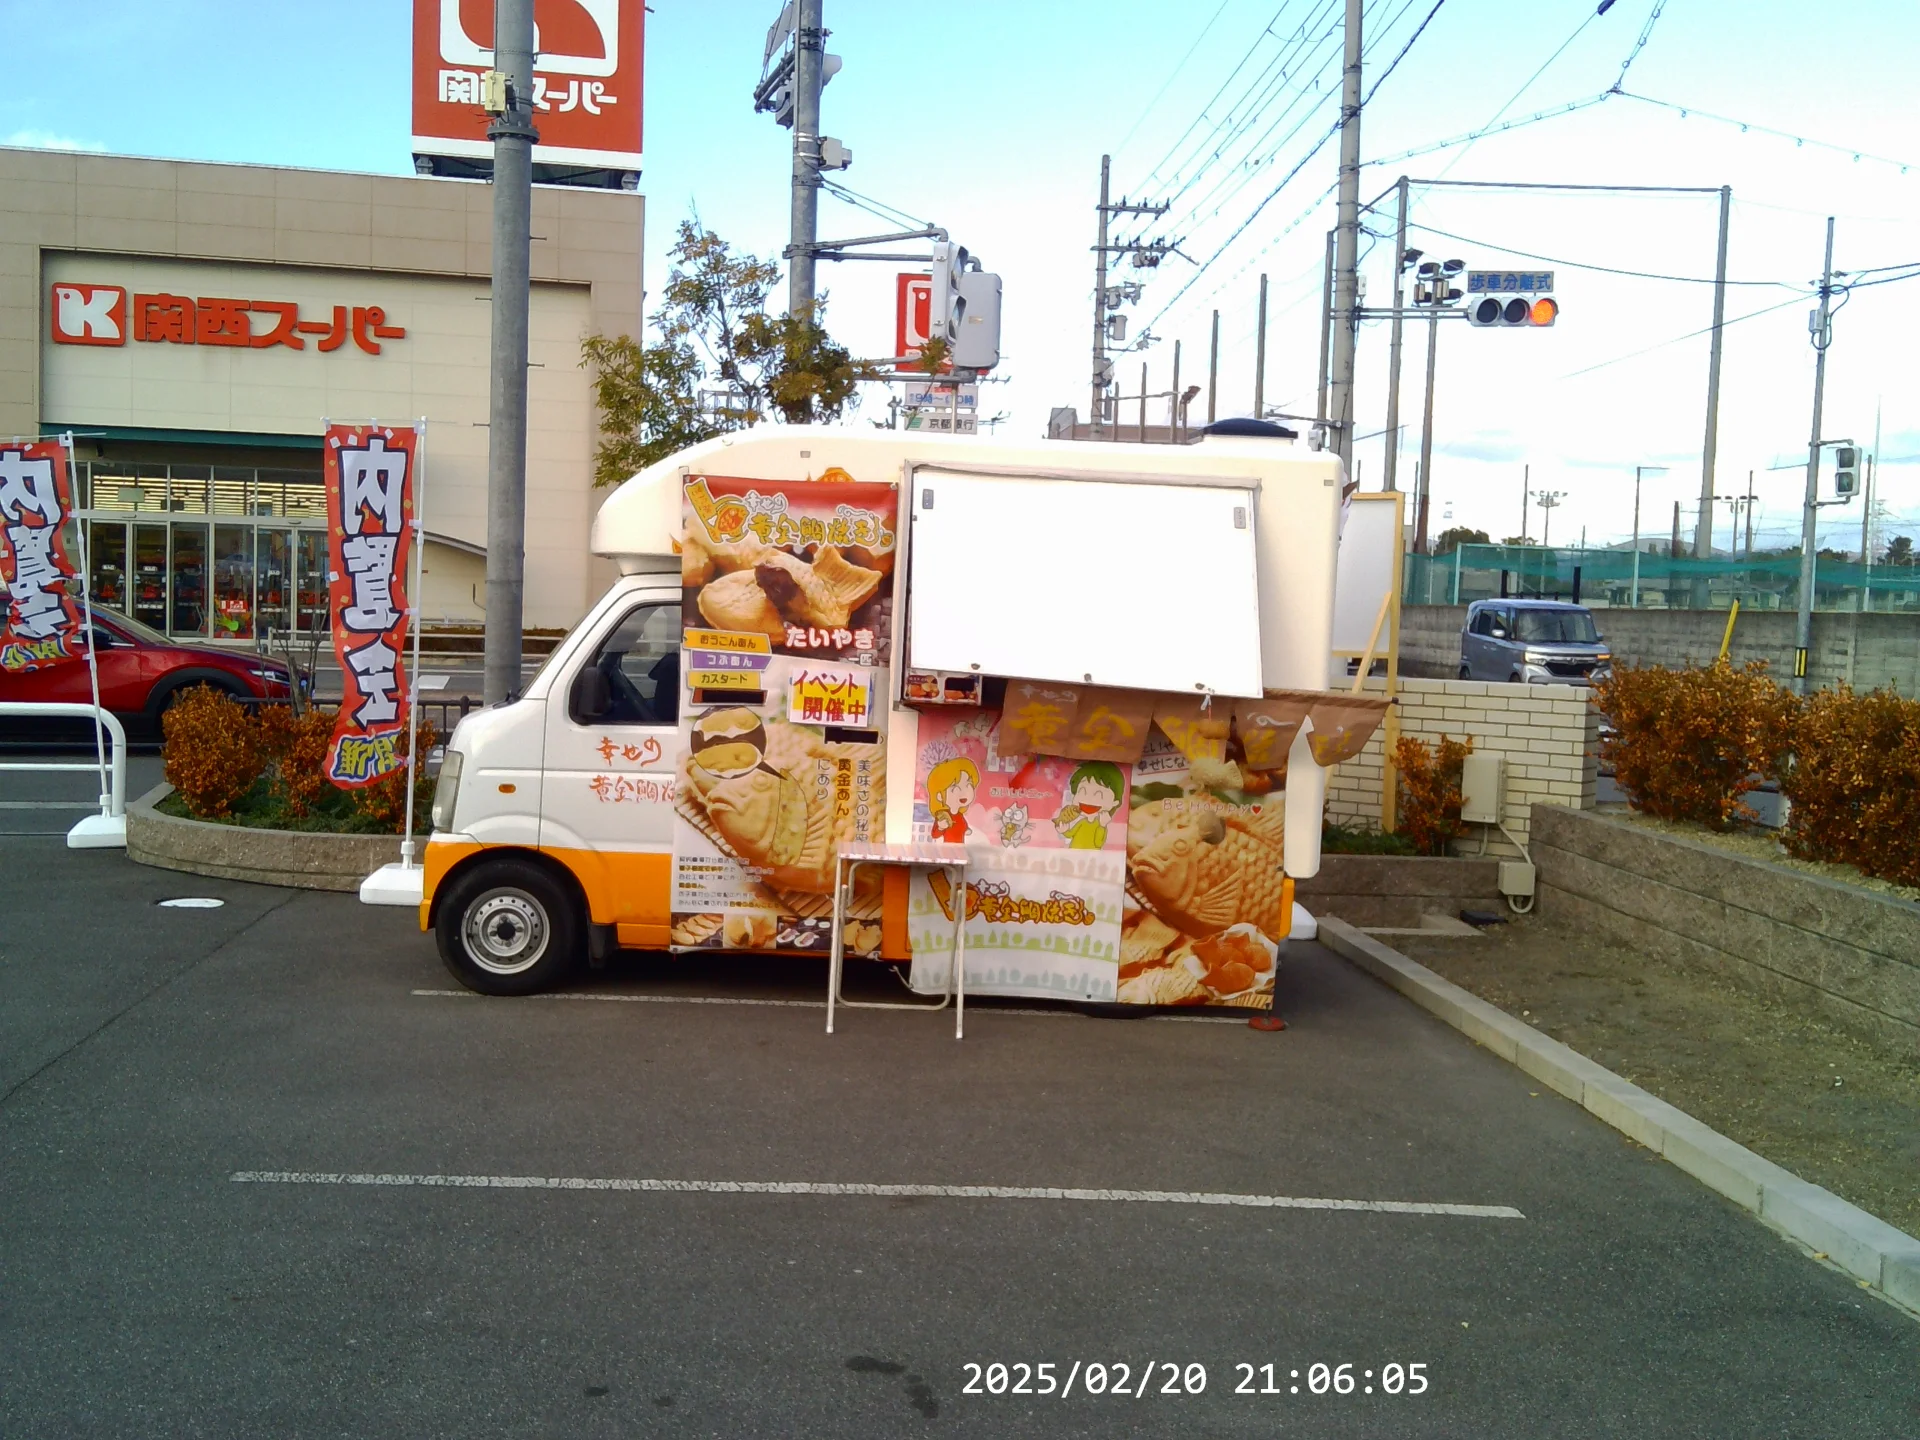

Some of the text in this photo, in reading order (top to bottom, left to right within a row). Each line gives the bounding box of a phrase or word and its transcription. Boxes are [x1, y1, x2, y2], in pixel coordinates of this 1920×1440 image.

[439, 69, 617, 115] 関スーパー
[1470, 273, 1551, 291] 歩車分離式
[133, 293, 406, 355] 関西スーパー
[786, 626, 875, 649] たいやき
[707, 654, 752, 668] つぶあん
[701, 673, 748, 684] カスタード
[793, 669, 858, 698] イベント
[803, 697, 867, 724] 開催中
[596, 736, 662, 767] 幸せの
[836, 758, 852, 816] 黄金あん
